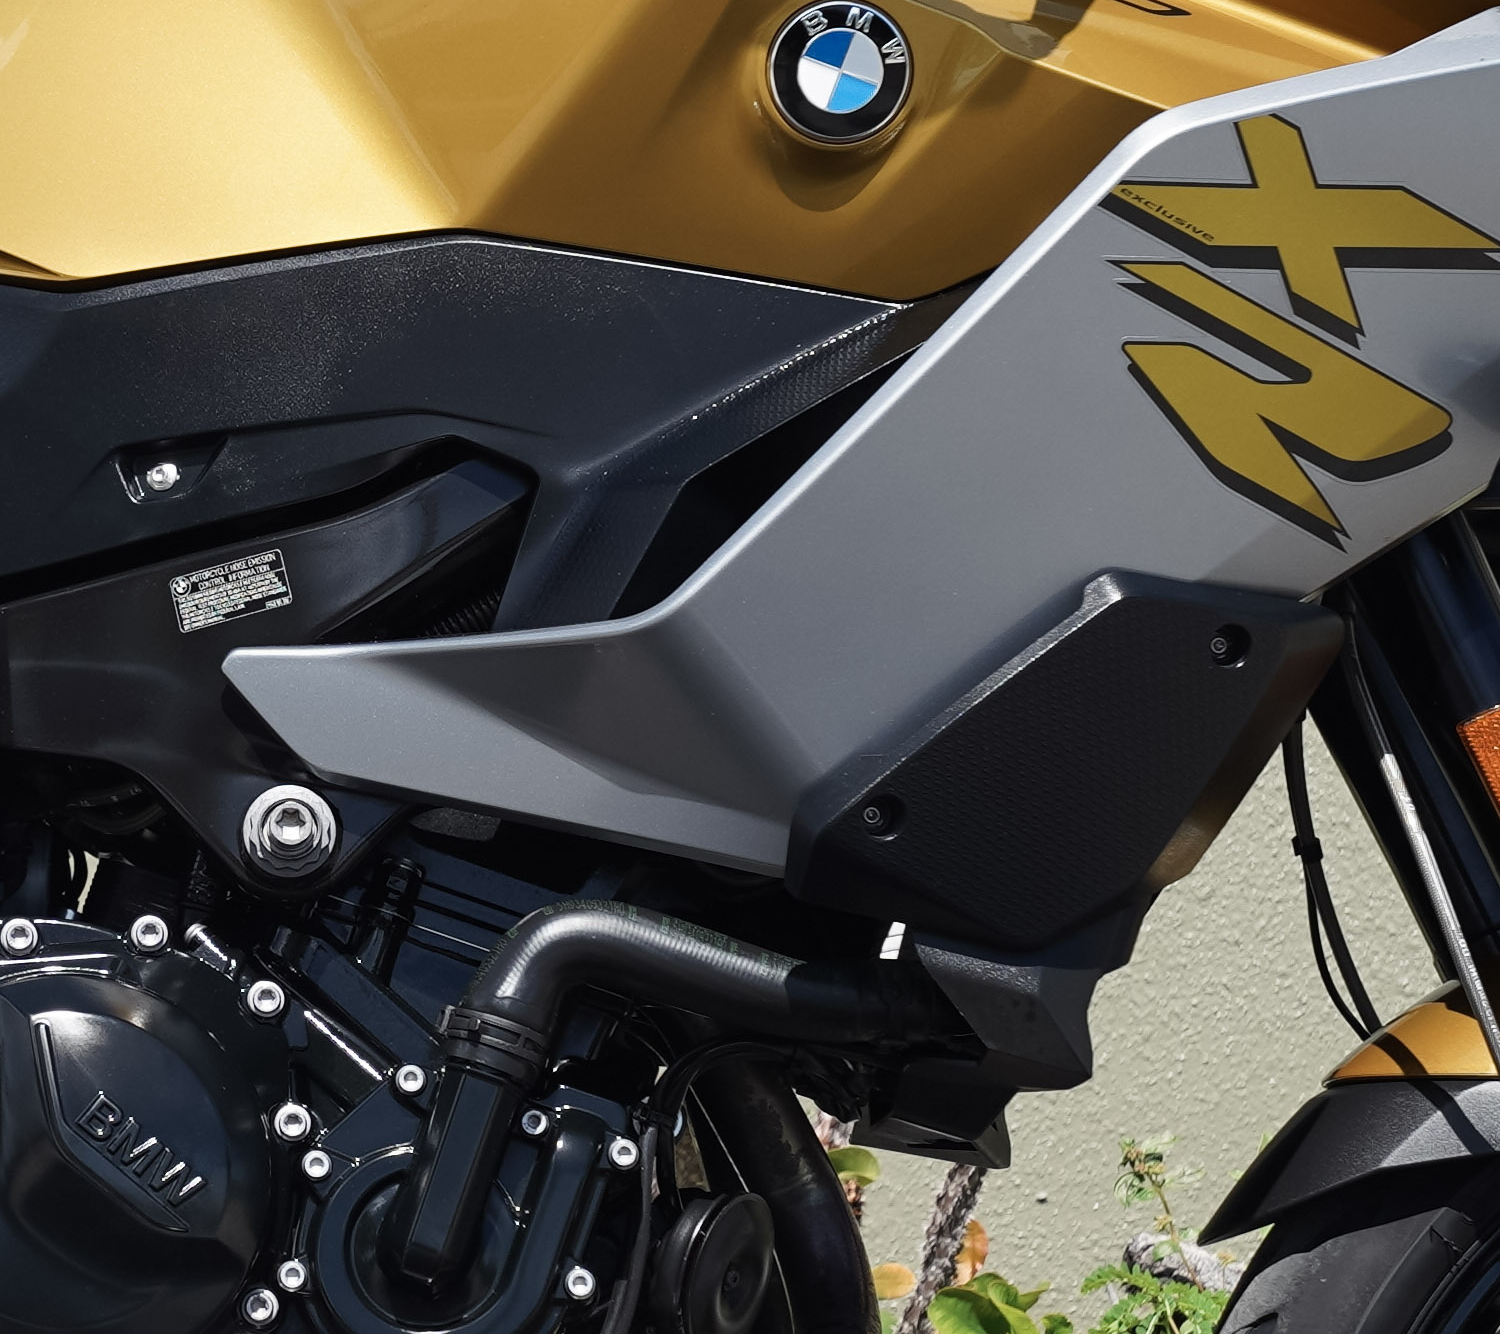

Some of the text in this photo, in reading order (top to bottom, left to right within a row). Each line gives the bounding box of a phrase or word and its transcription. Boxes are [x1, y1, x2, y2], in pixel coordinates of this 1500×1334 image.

[801, 6, 906, 65] BMW
[1120, 186, 1215, 243] exclusive
[76, 1092, 208, 1206] BMW
